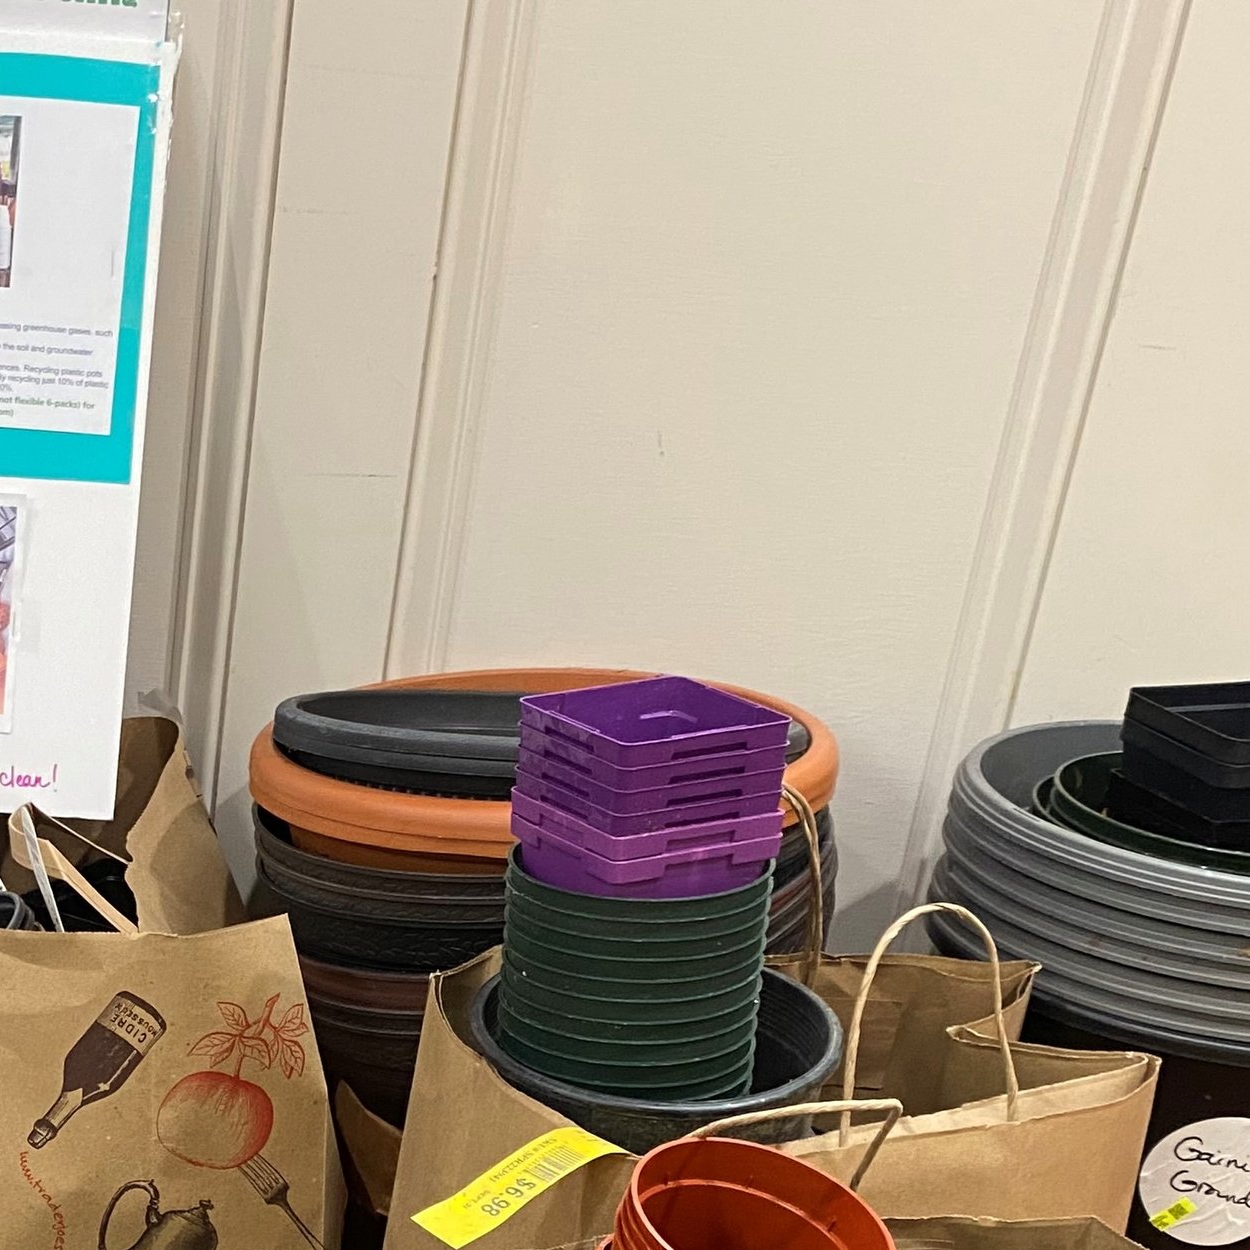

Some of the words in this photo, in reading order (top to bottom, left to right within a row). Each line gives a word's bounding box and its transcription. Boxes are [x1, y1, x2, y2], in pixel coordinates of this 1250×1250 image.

[0, 764, 57, 792] clean!
[111, 1014, 147, 1043] CIDRE
[481, 1178, 536, 1216] $6.98
